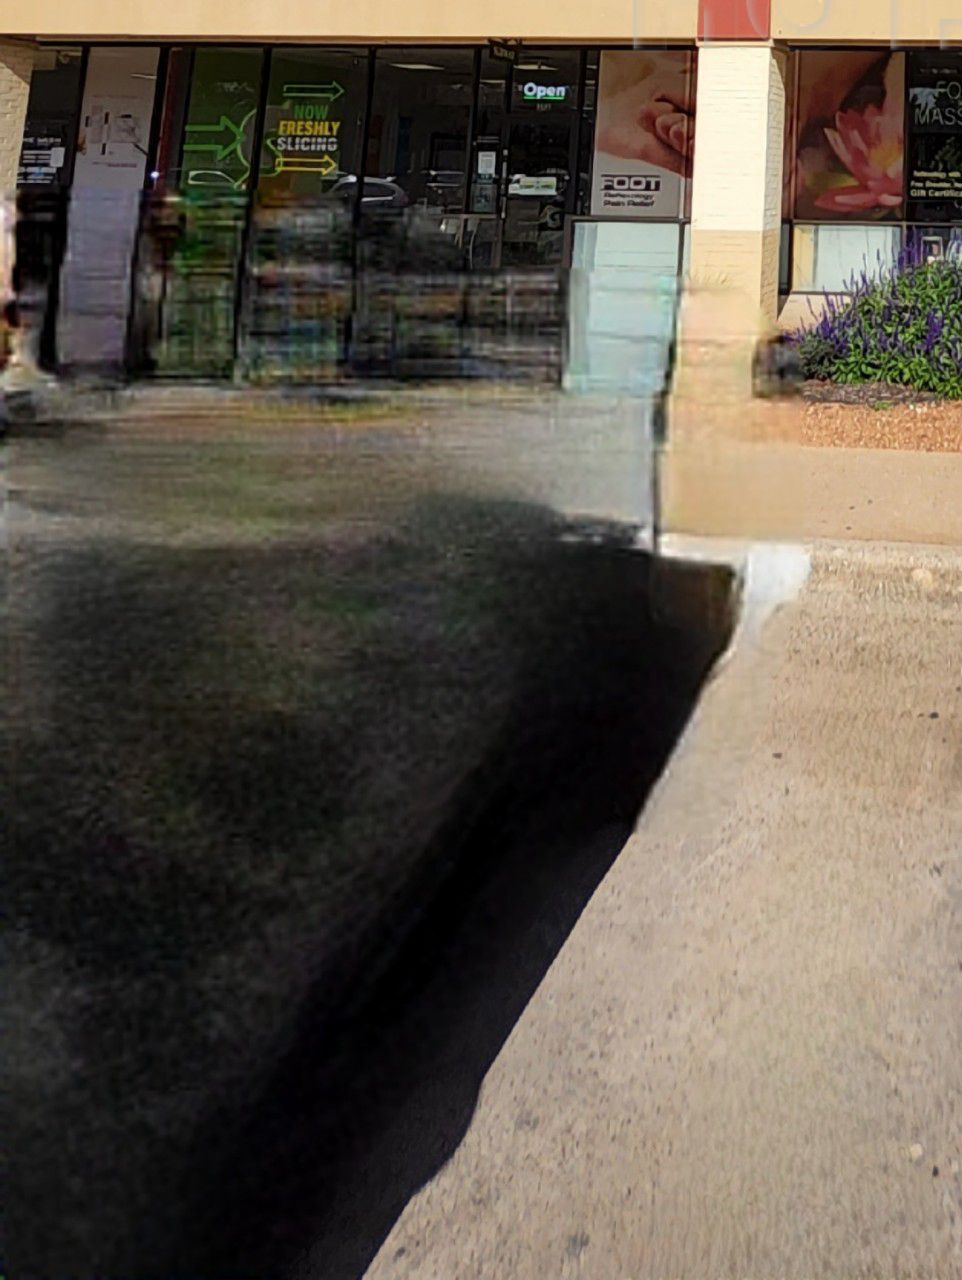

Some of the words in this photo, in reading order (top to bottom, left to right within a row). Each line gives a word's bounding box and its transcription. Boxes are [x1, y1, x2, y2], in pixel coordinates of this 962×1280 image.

[523, 81, 566, 99] Open
[293, 105, 328, 120] NOW
[278, 121, 341, 136] FRESHLY
[277, 137, 338, 152] SLICING
[600, 175, 660, 190] FOOT
